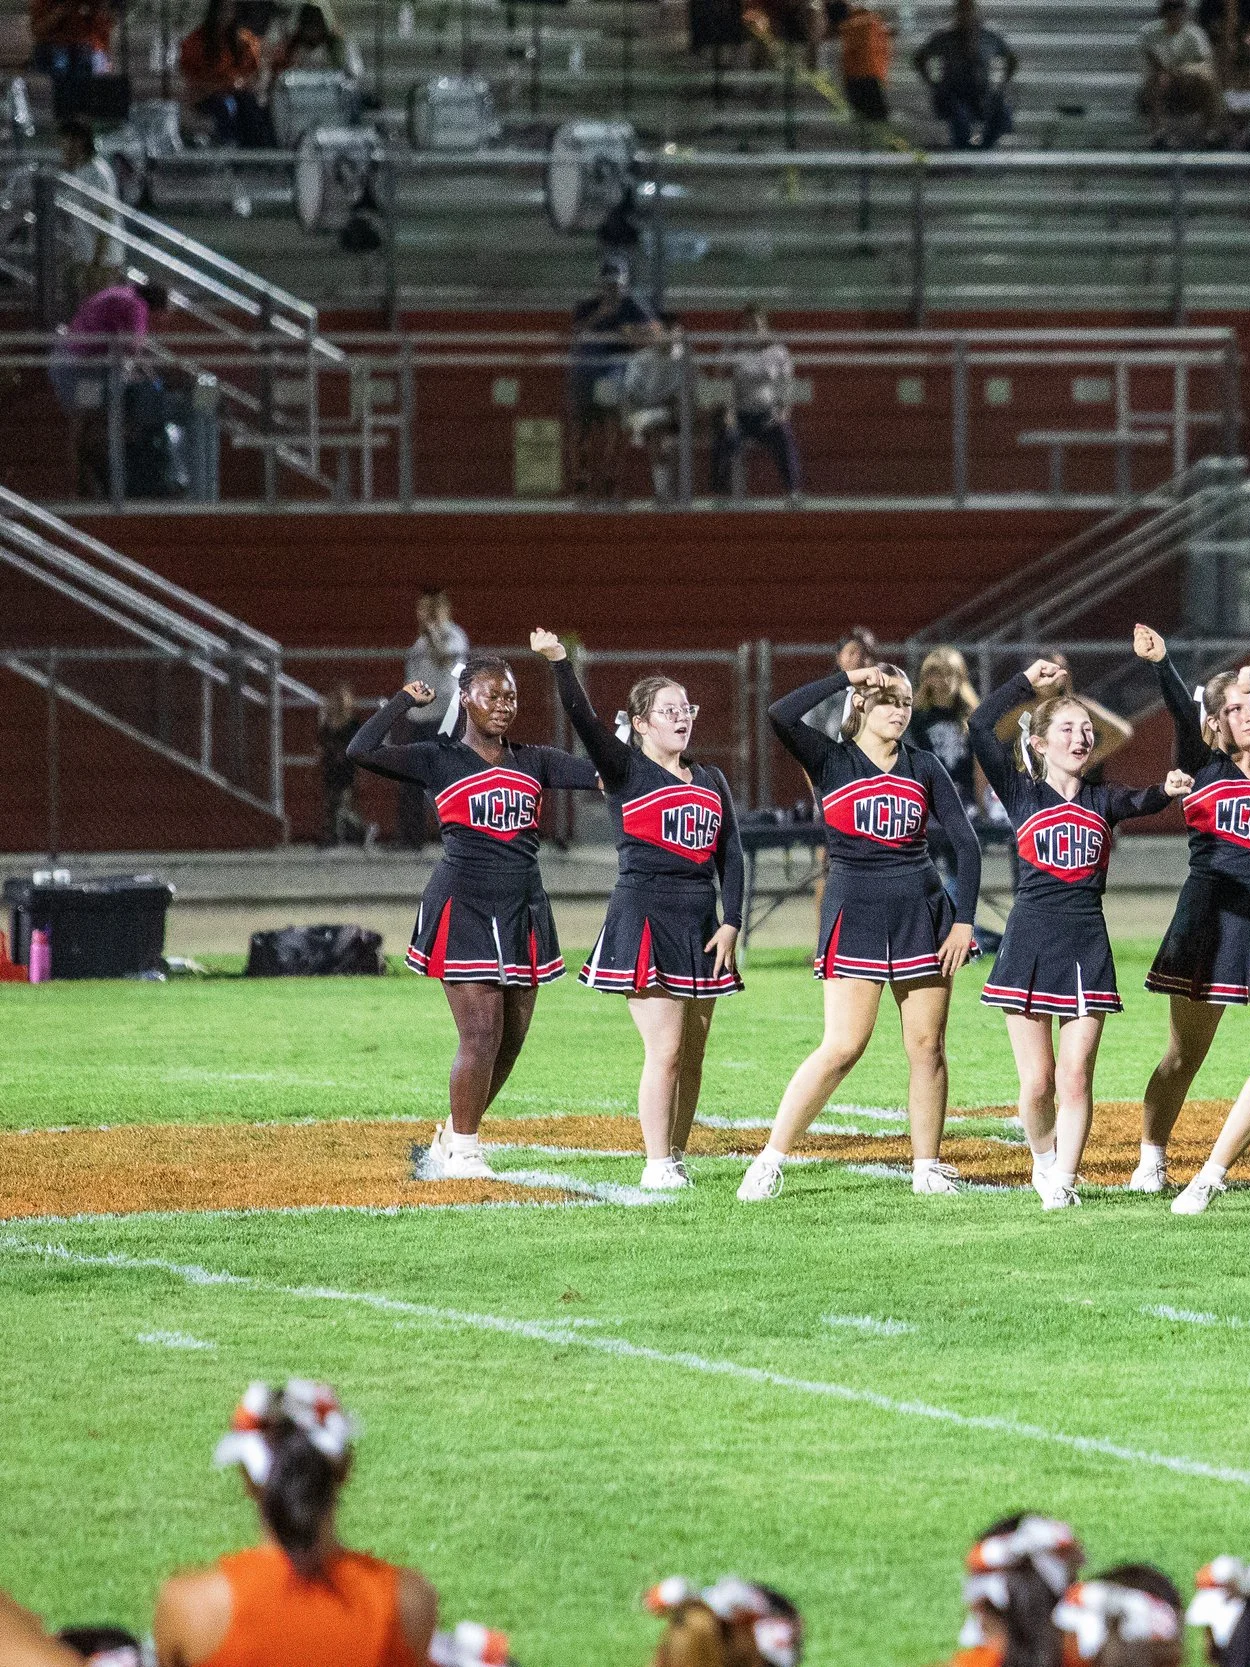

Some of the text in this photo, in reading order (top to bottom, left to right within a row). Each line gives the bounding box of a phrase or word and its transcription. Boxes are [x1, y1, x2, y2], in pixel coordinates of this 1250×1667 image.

[468, 787, 536, 832] WCHS
[661, 803, 721, 850] WCHS
[854, 794, 923, 841] WCHS
[1033, 822, 1104, 870] WCHS
